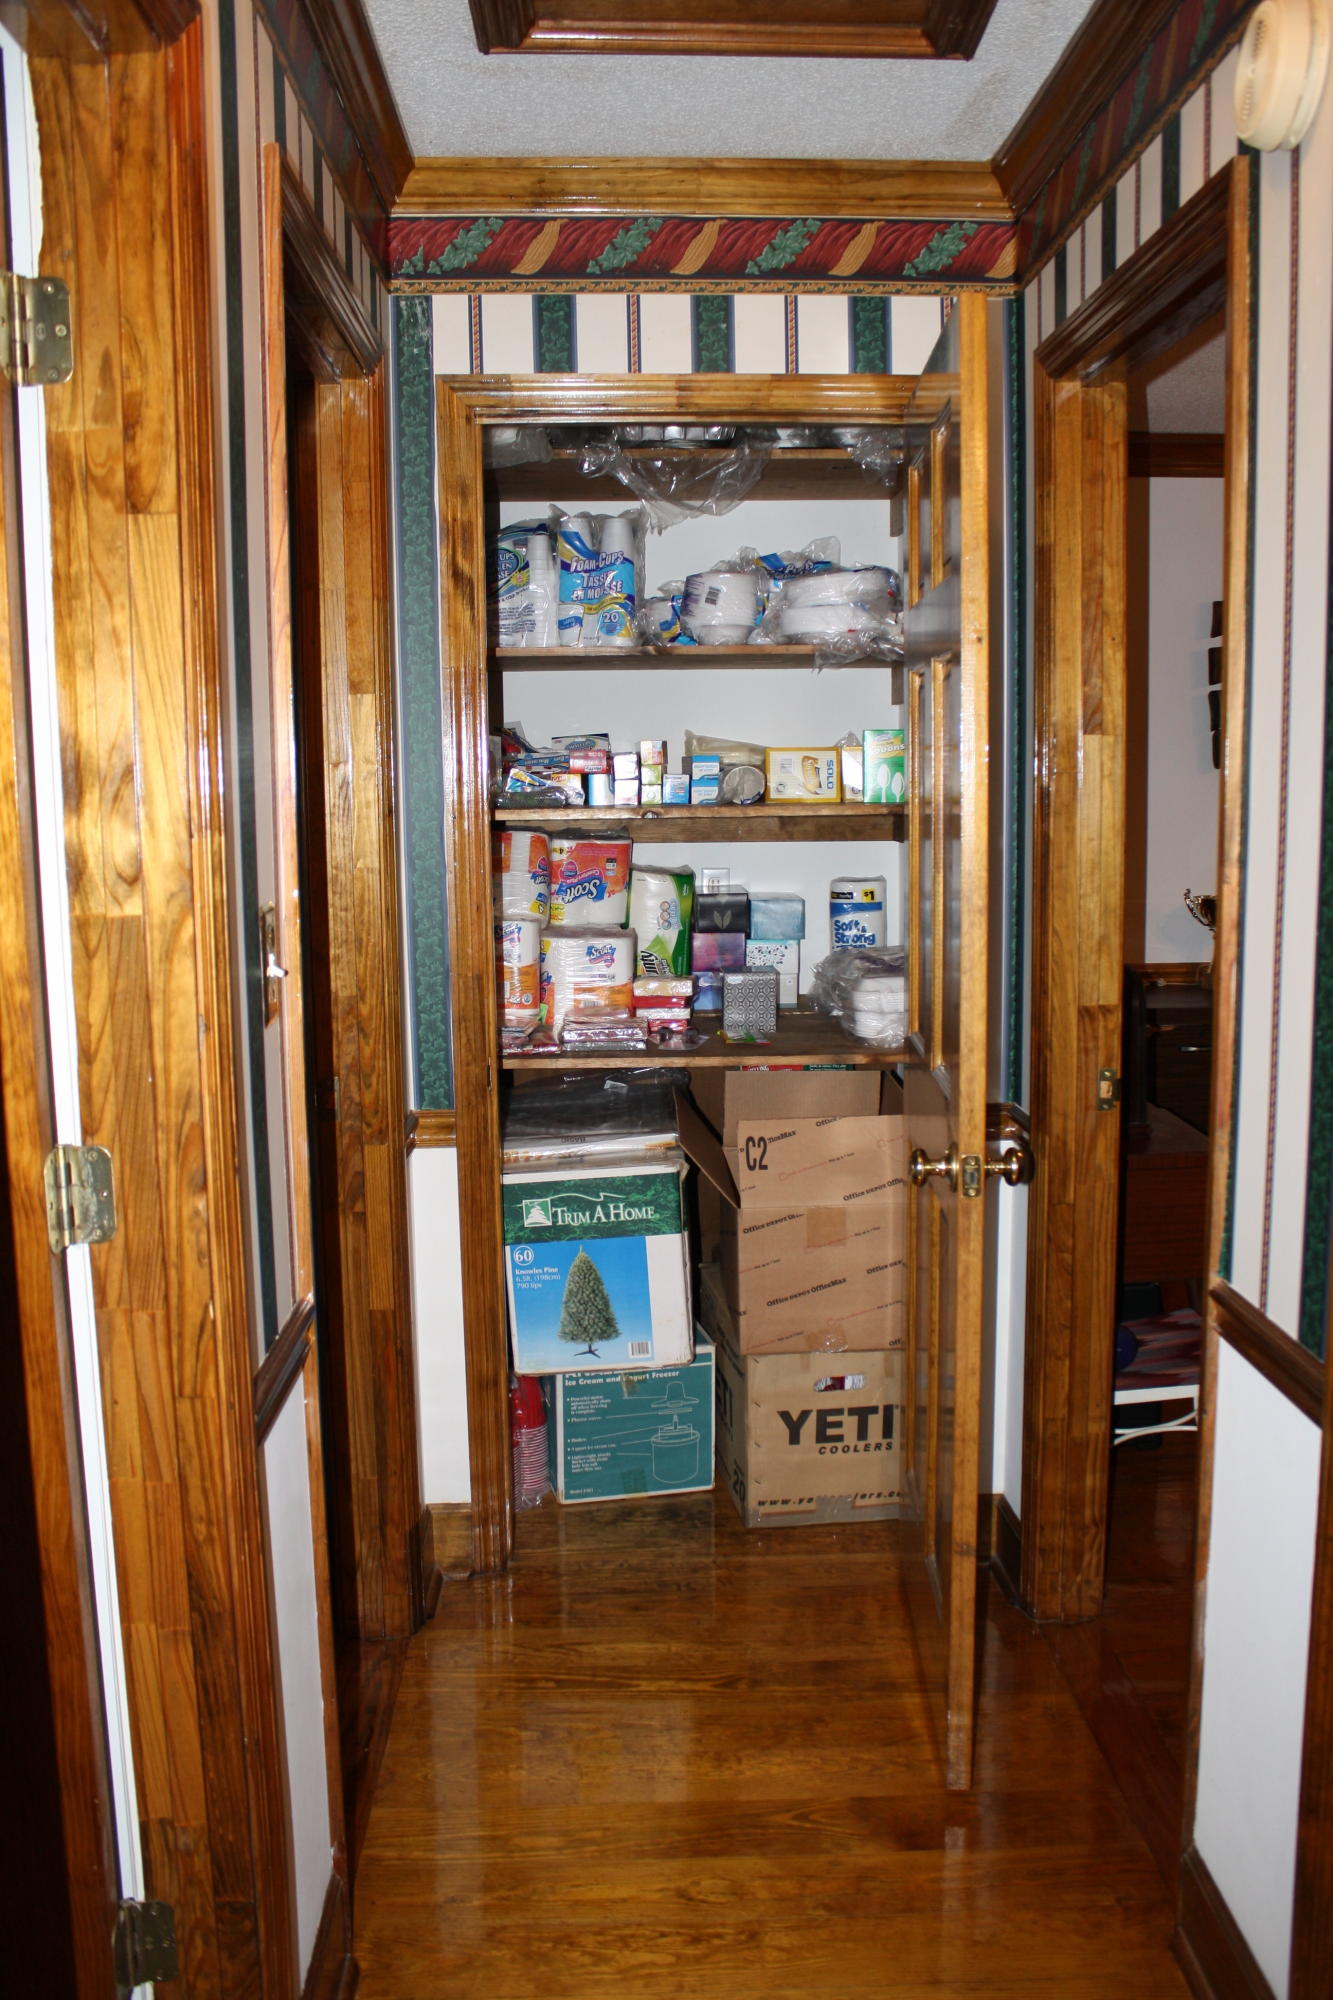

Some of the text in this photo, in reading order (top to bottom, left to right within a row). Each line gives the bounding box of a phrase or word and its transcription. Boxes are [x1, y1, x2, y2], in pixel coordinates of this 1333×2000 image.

[598, 551, 624, 568] CUPS
[604, 612, 620, 624] 20
[826, 759, 835, 790] SOLO
[561, 878, 601, 904] Scott
[863, 890, 875, 902] $1
[745, 1135, 768, 1171] C2
[552, 1202, 656, 1226] TRIM A HOME
[514, 1250, 532, 1262] 60
[565, 1379, 577, 1387] Ice
[578, 1377, 604, 1386] Cream
[606, 1375, 621, 1383] and
[652, 1370, 680, 1379] Freezer
[776, 1404, 894, 1446] YETI
[818, 1441, 894, 1456] COOLERS
